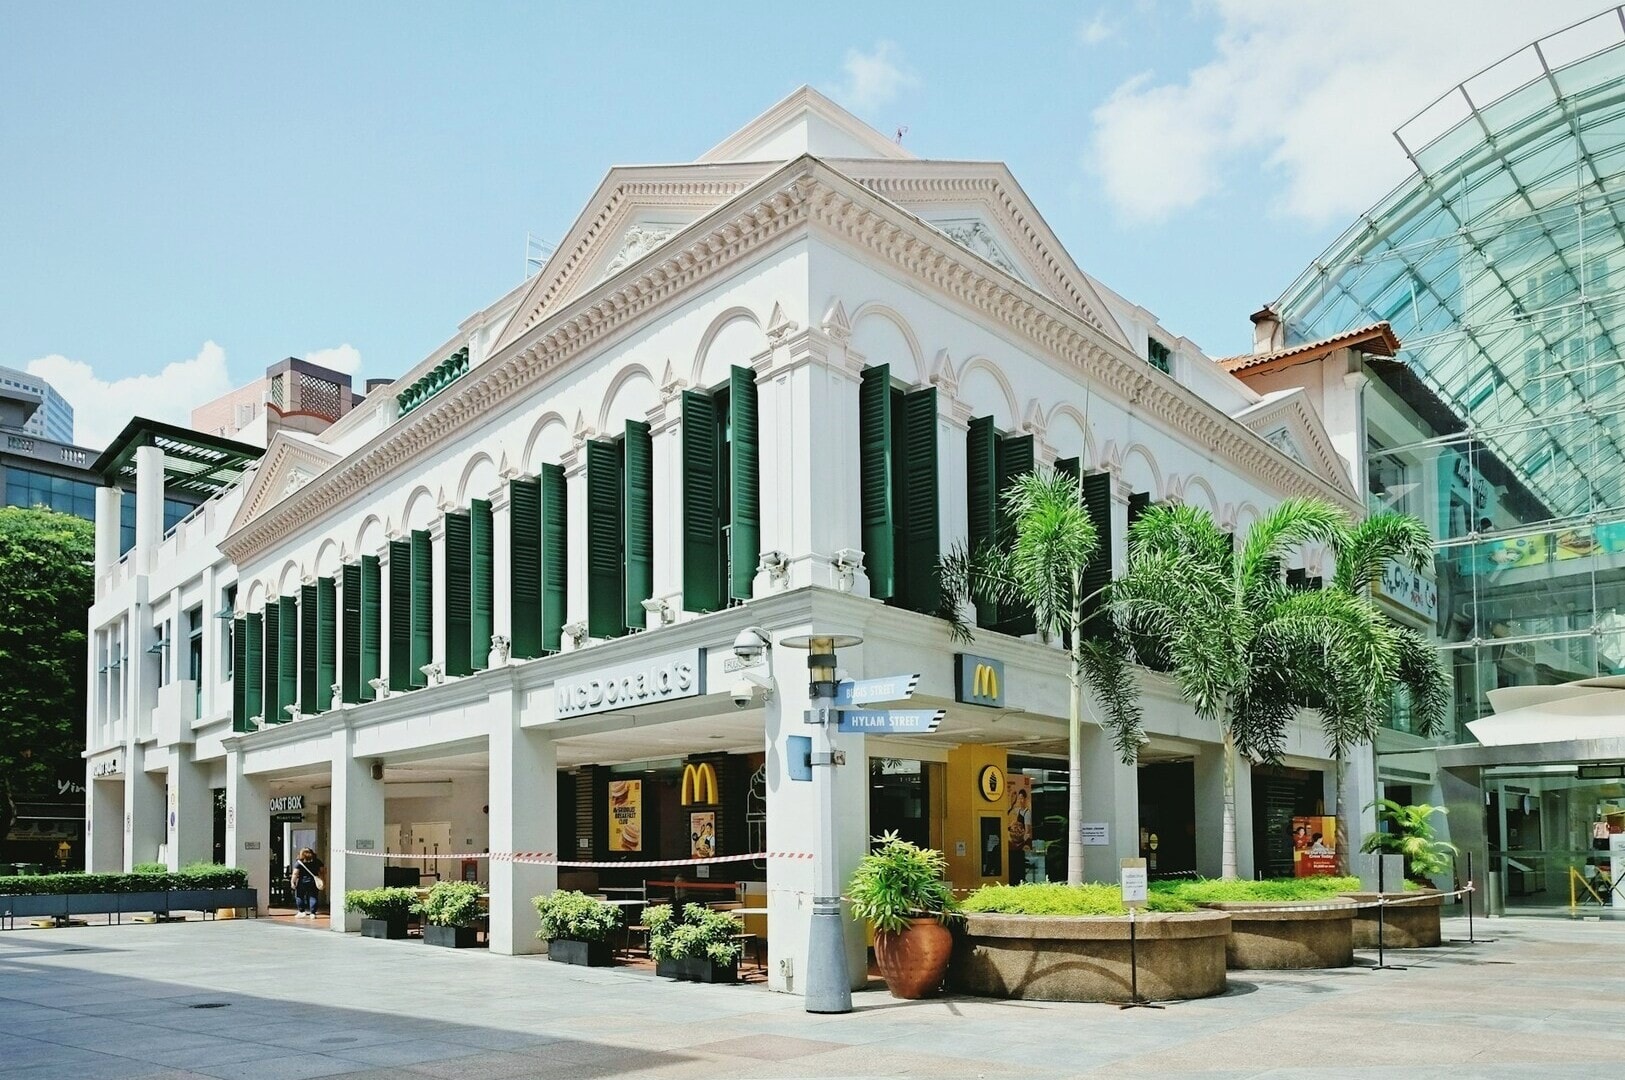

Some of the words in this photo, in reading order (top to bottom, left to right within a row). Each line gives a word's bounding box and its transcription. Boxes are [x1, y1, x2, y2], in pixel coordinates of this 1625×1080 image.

[558, 661, 692, 713] McDonald's
[846, 687, 868, 699] BUGIS
[870, 683, 896, 696] STREET
[851, 716, 885, 727] HYLAM
[889, 715, 920, 726] STREET
[287, 795, 302, 809] BOX
